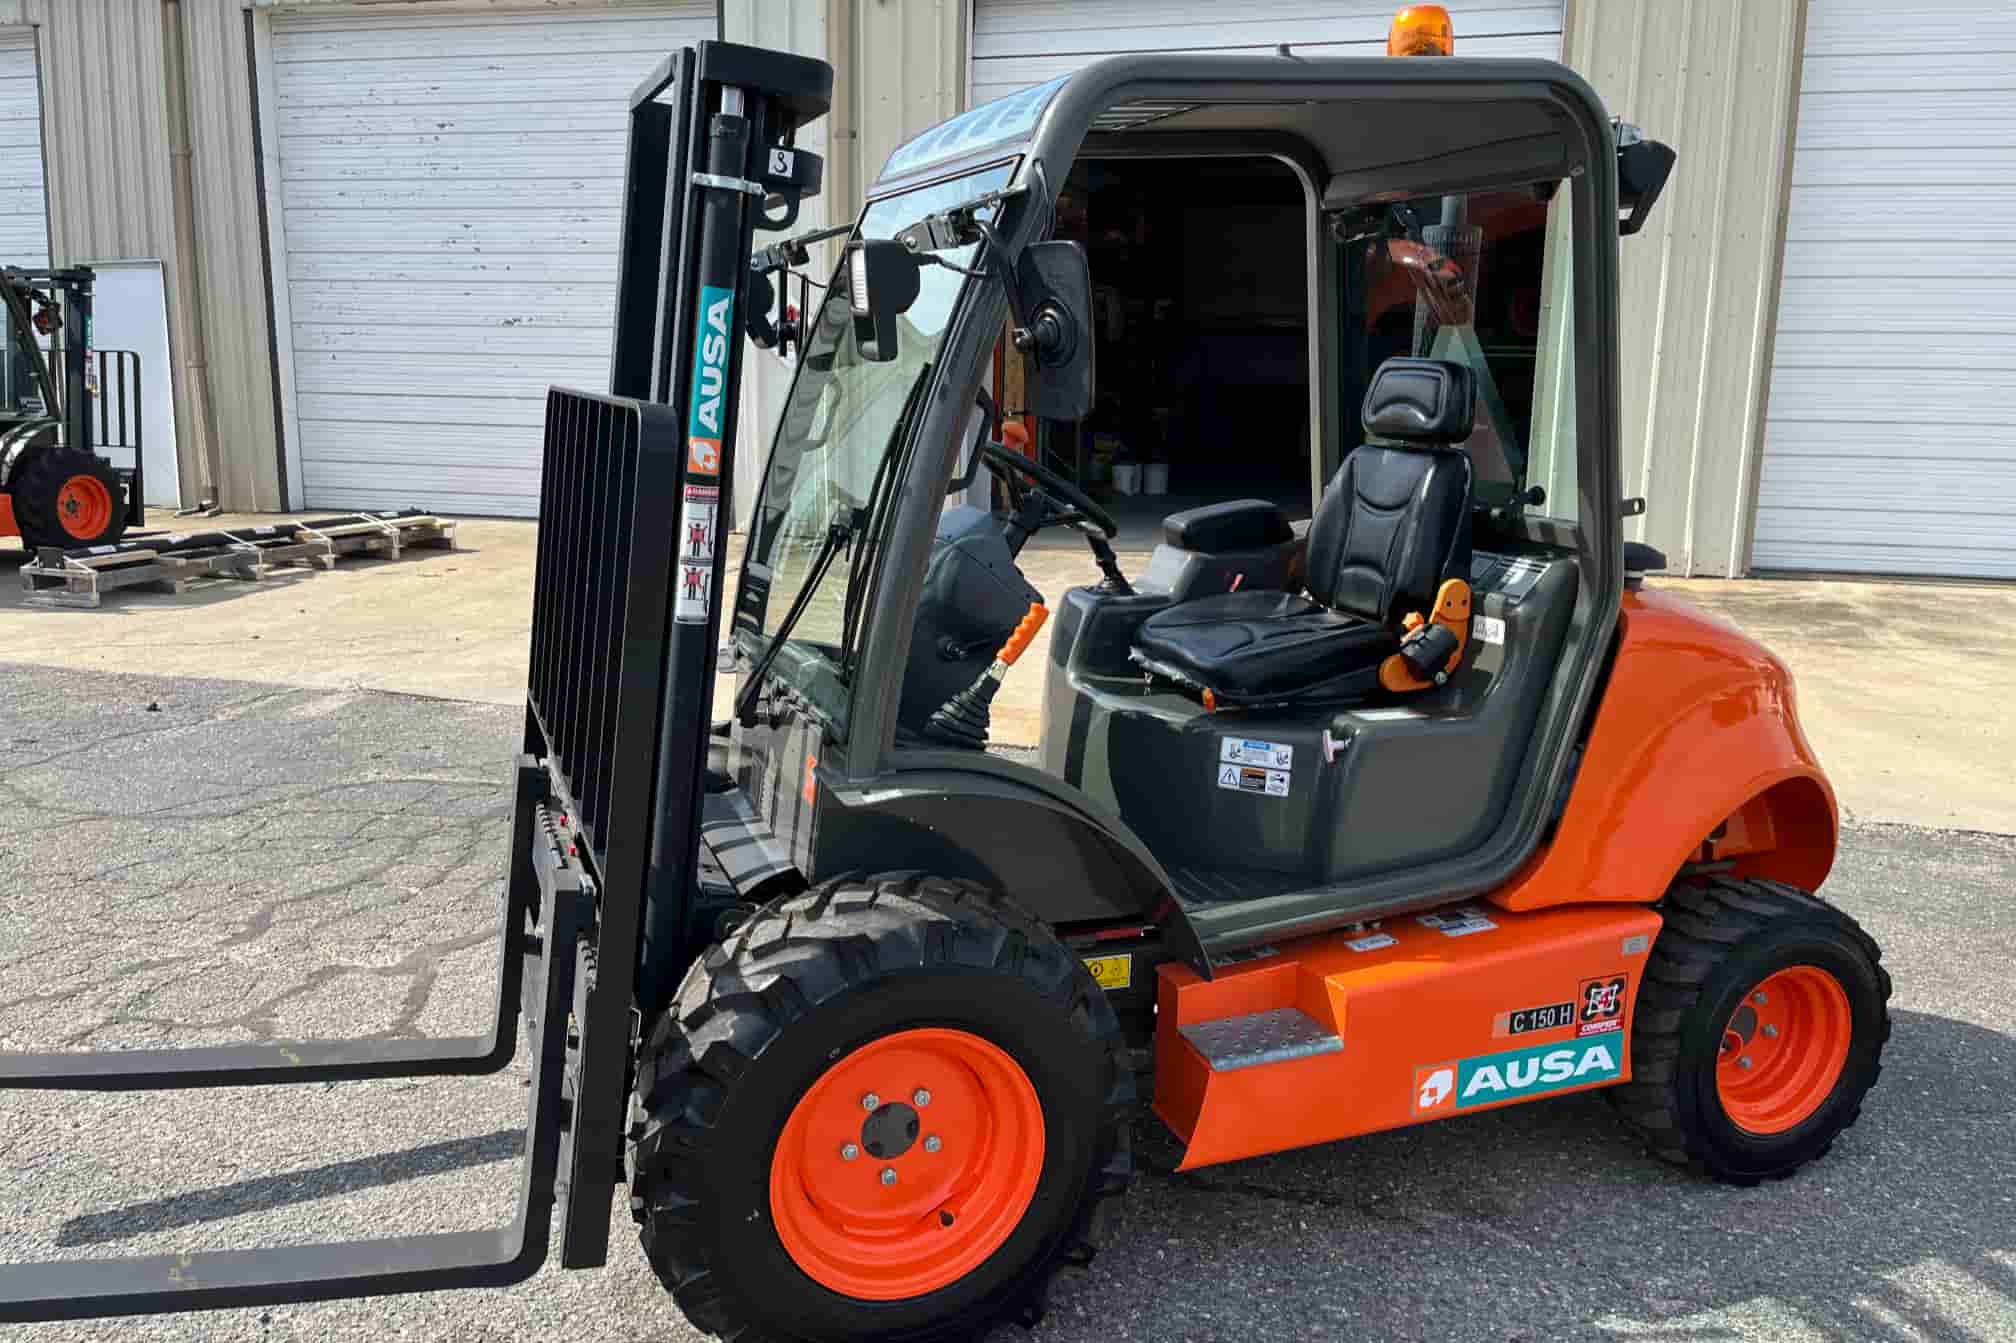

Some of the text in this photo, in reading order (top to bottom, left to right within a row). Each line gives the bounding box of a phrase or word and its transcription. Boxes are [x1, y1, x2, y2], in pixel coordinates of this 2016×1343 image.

[698, 296, 730, 433] AUSA
[1513, 1005, 1572, 1032] C 150 H
[1462, 1044, 1616, 1098] AUSA
